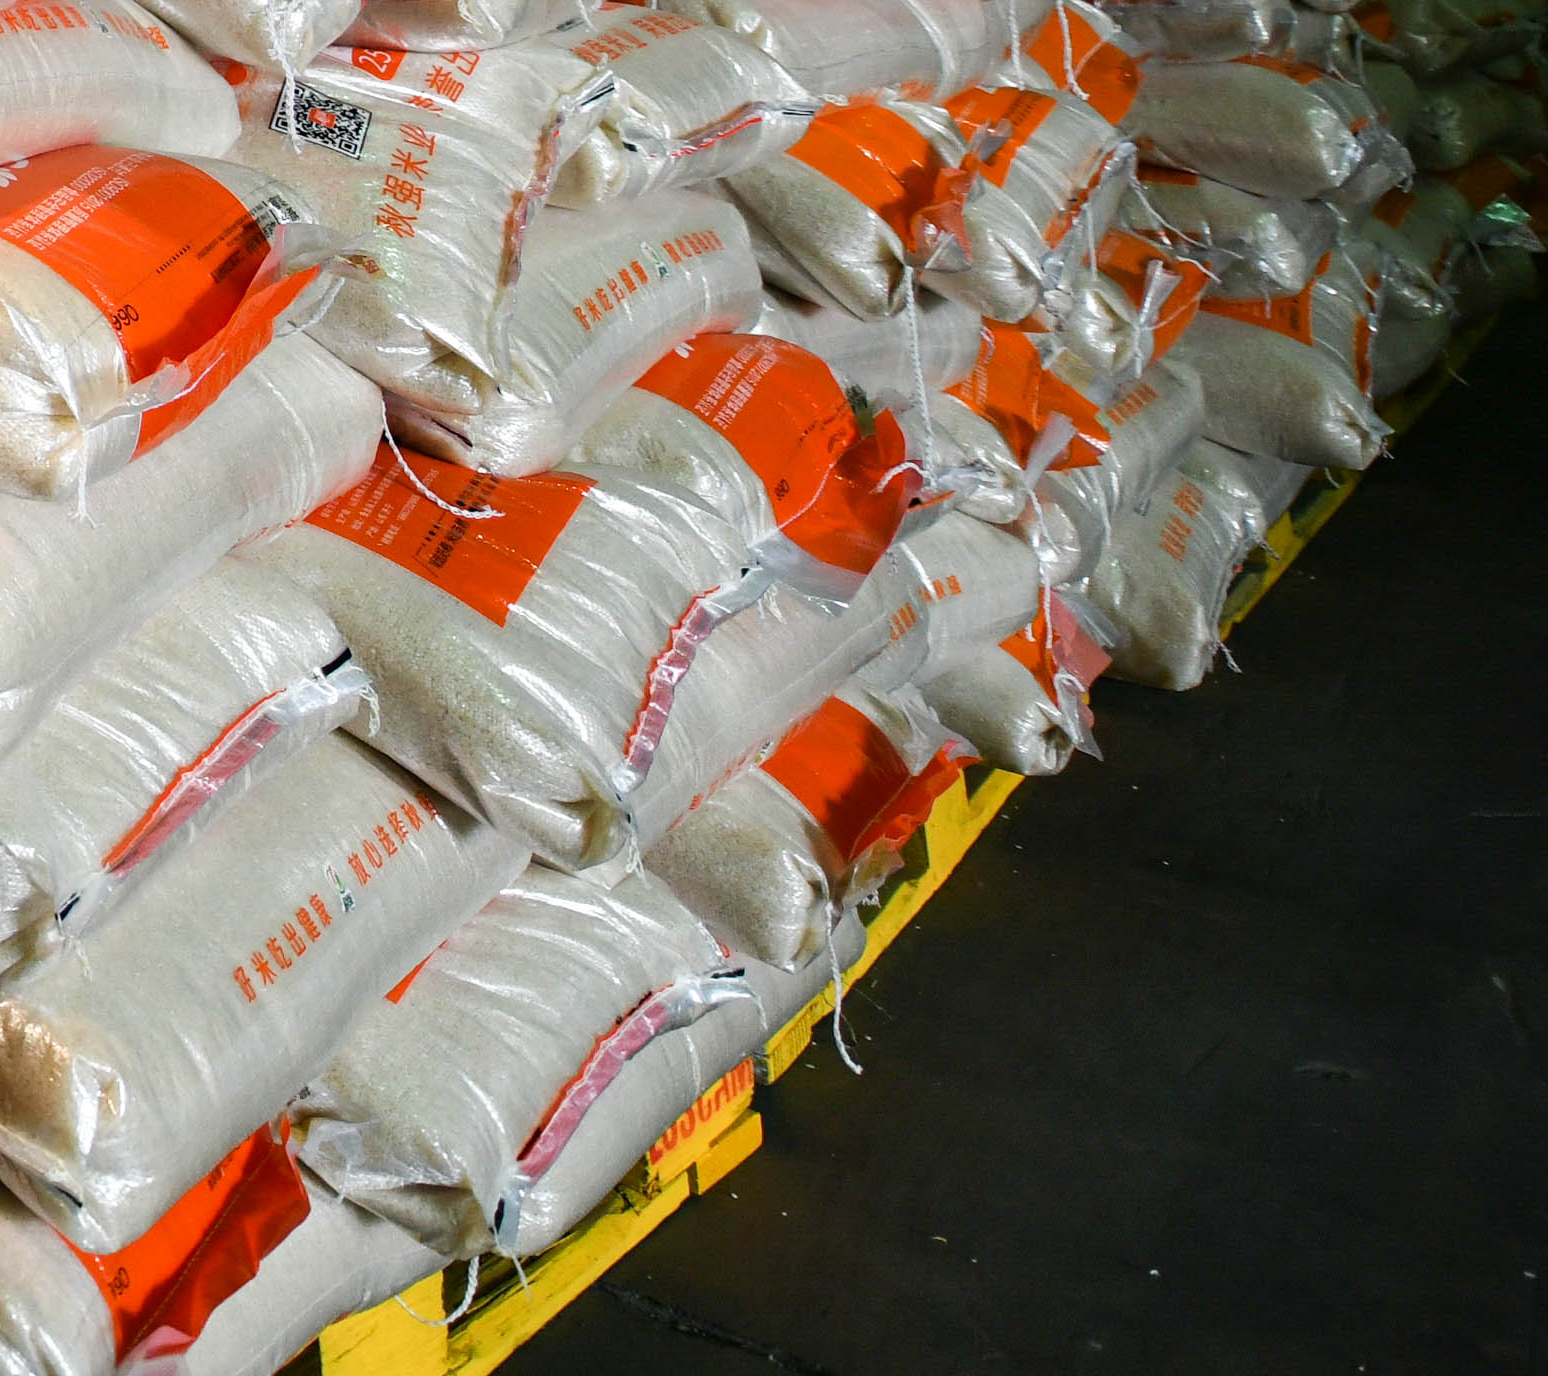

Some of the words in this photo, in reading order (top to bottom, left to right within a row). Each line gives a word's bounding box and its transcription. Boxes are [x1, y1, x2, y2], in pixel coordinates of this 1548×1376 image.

[375, 124, 436, 238] 秋强米业
[233, 894, 333, 1003] 好米吃出健康
[347, 789, 441, 885] 放心选择秋强
